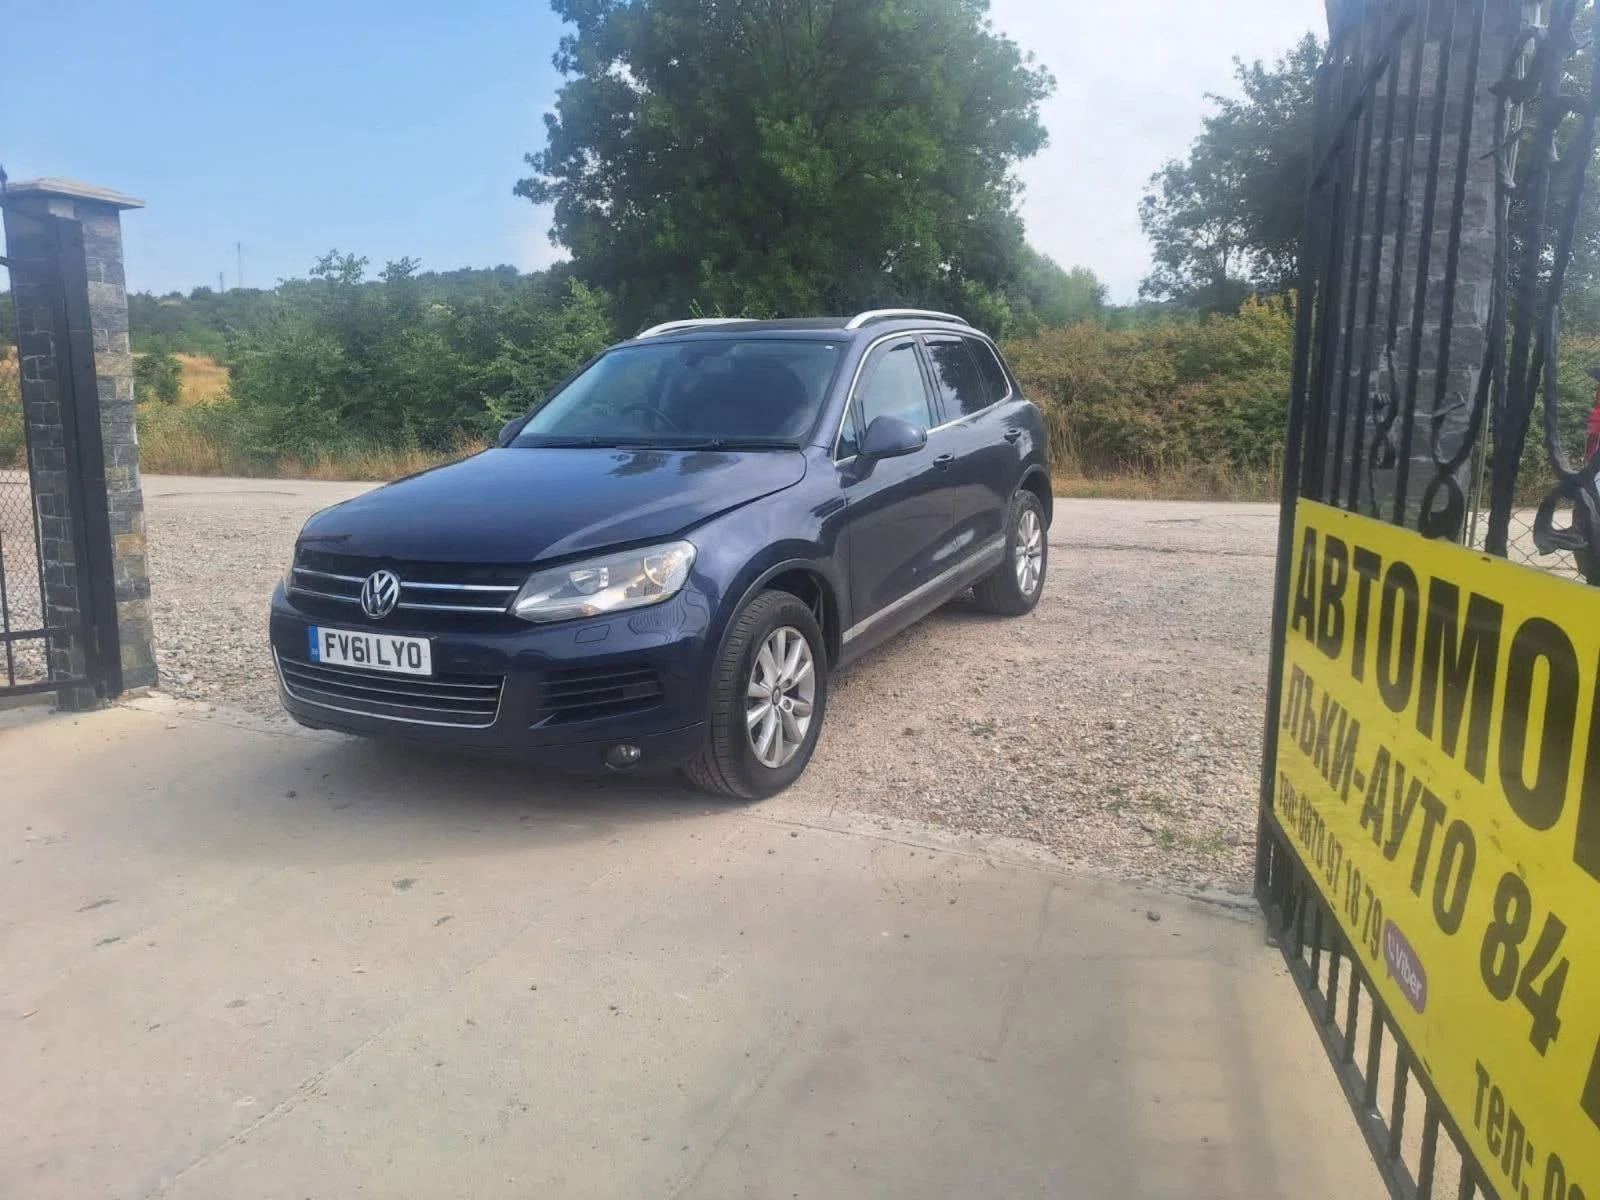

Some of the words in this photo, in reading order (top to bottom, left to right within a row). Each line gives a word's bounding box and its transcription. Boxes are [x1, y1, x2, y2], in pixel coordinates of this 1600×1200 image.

[1326, 831, 1343, 895] 97
[1345, 860, 1361, 927] 18
[1362, 883, 1383, 961] 79
[1480, 871, 1570, 1058] 84
